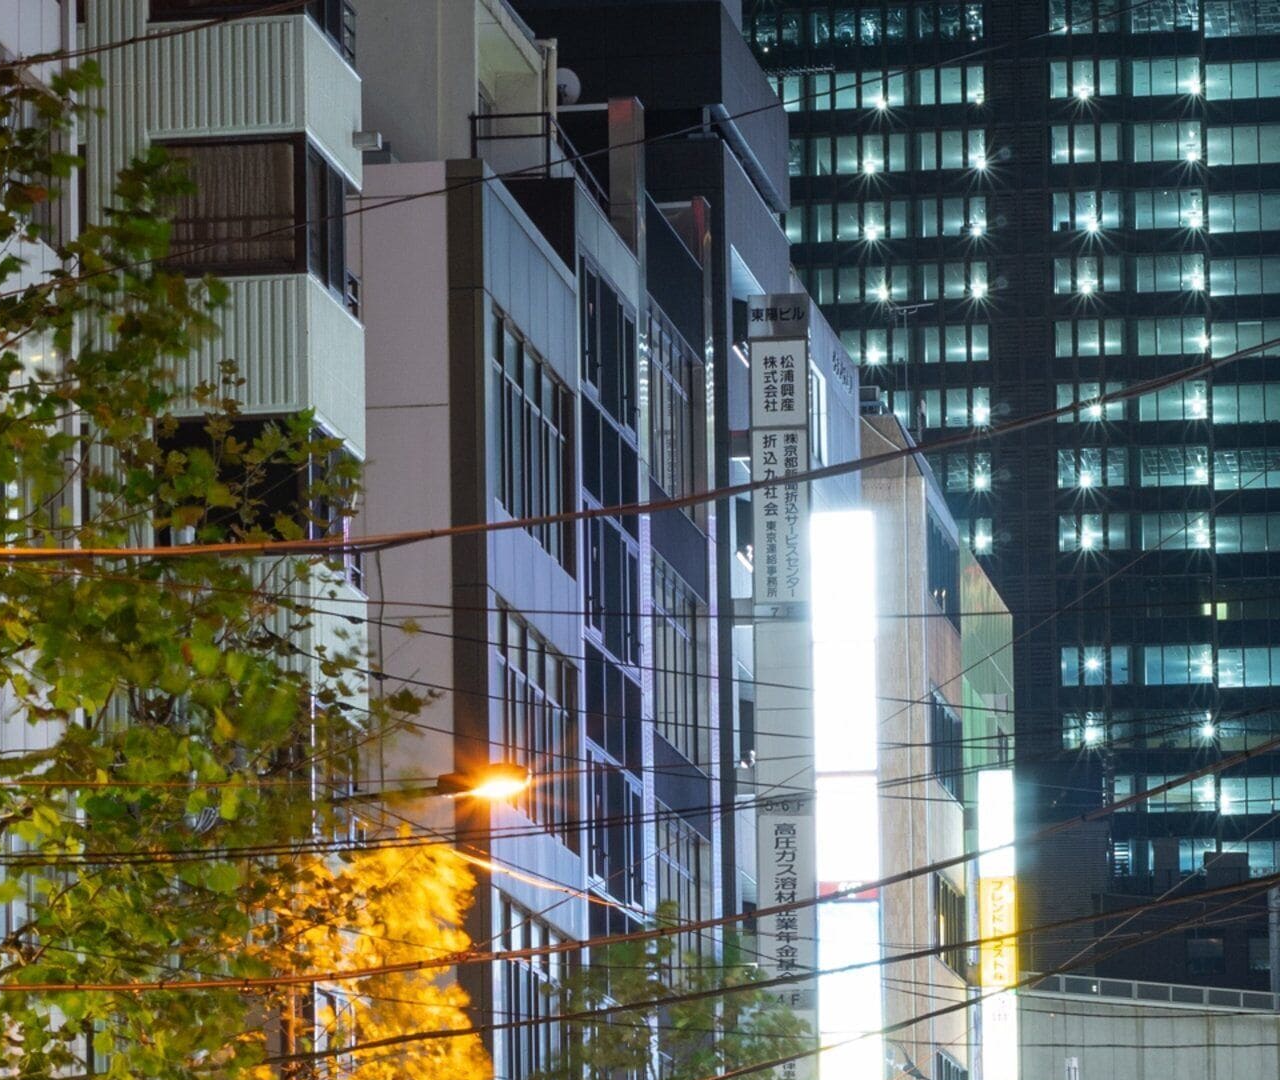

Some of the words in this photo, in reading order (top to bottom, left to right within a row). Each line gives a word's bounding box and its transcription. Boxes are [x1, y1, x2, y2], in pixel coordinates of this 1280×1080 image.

[751, 307, 805, 322] 東陽ビル
[762, 355, 778, 413] 株式会社
